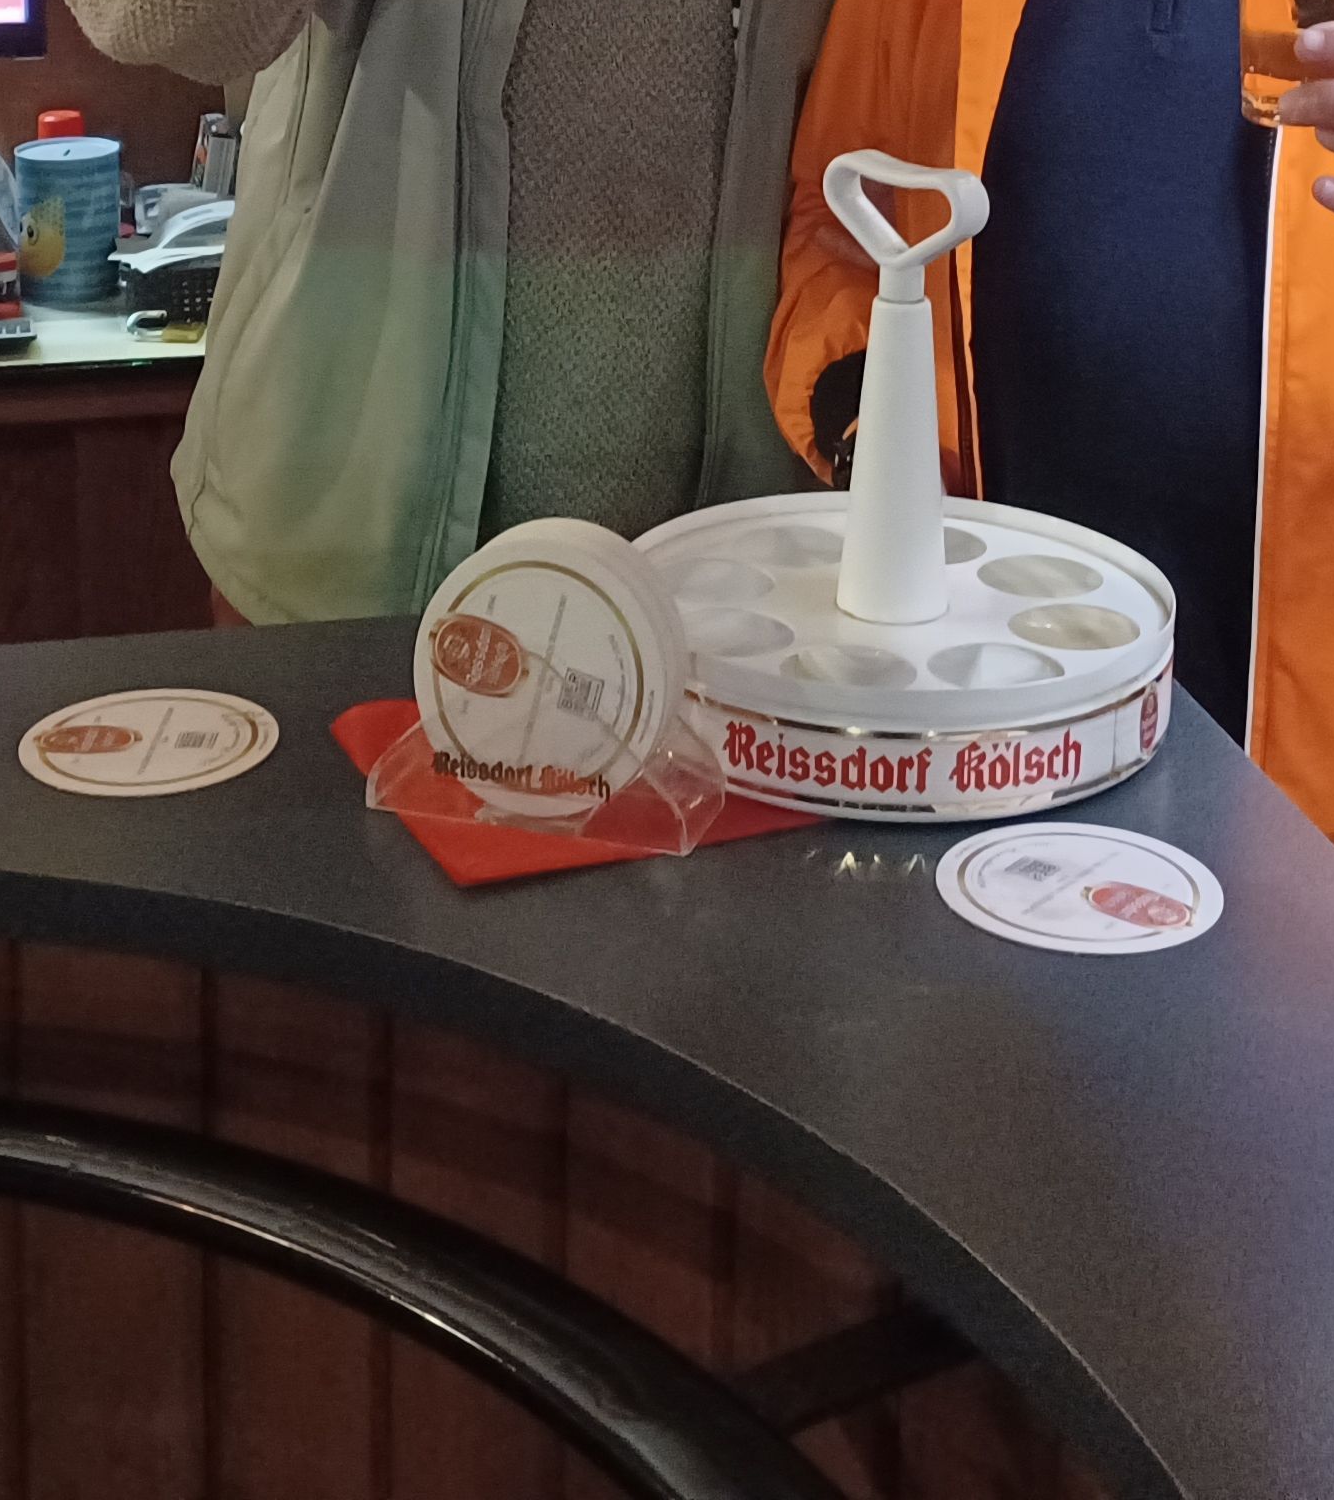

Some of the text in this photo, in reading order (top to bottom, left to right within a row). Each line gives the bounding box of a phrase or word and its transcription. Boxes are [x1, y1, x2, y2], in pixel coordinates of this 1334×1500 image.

[431, 751, 611, 803] Reissdorf Kölsch
[722, 719, 1083, 795] Reissdorf Kölsch
